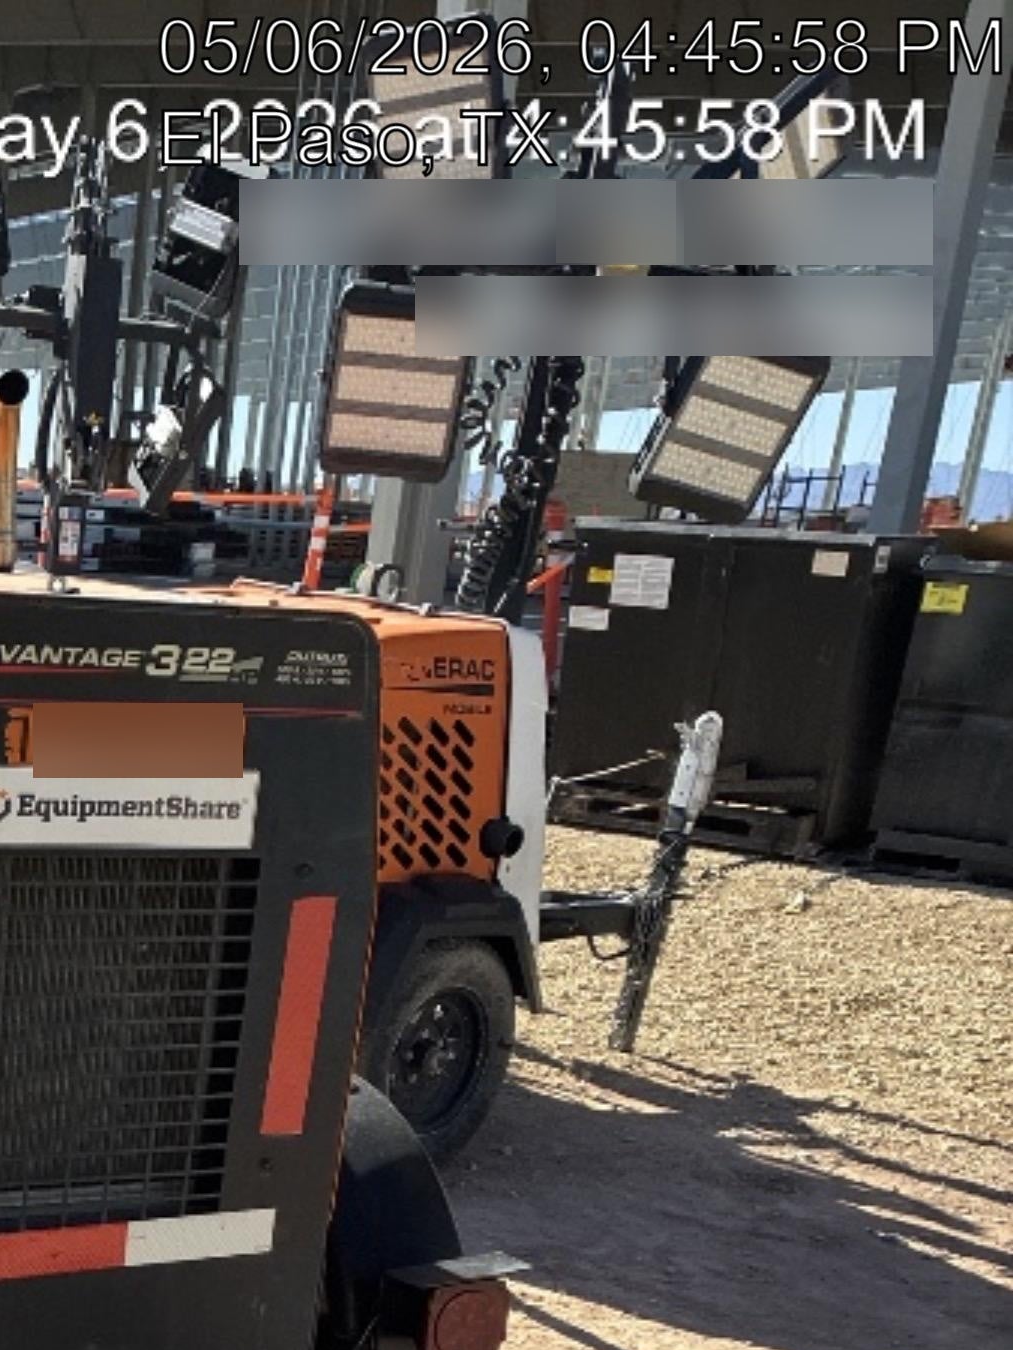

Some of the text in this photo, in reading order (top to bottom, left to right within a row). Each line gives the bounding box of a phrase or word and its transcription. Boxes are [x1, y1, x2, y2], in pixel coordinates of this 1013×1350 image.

[0, 644, 237, 676] VANTAGE 322
[17, 794, 243, 823] EquipmentShare
